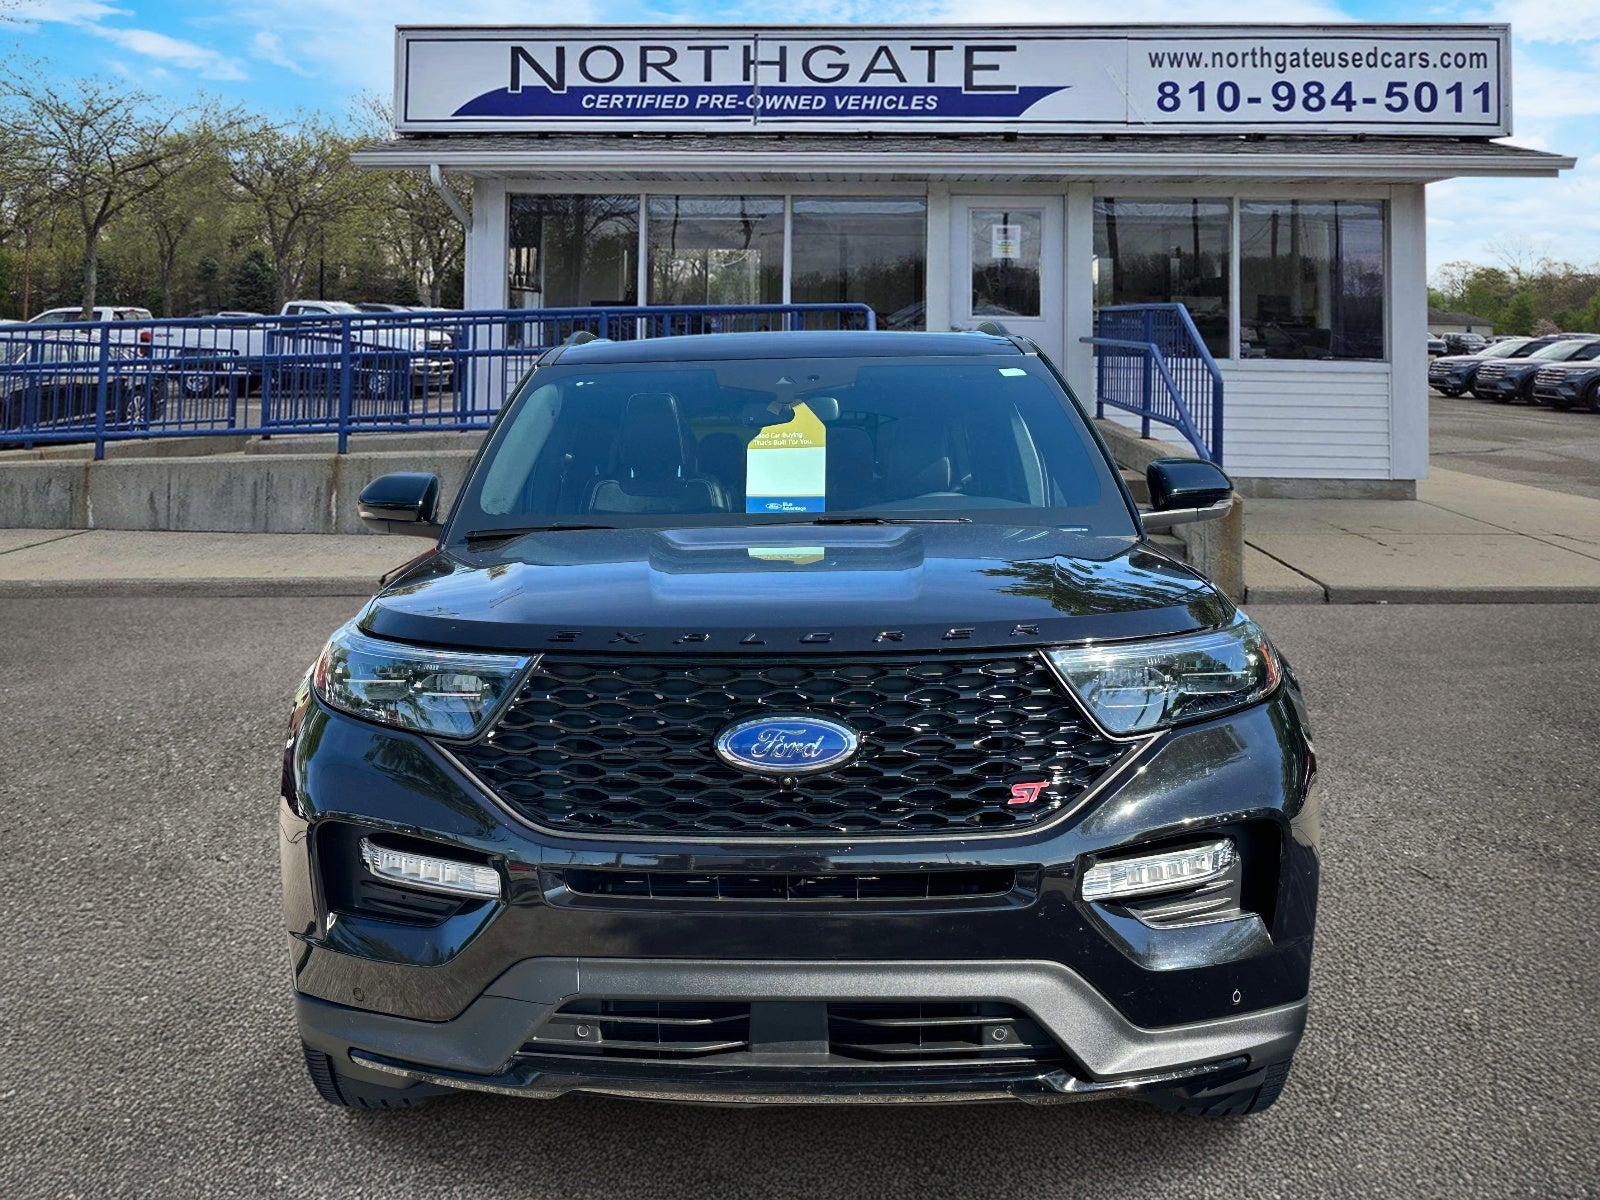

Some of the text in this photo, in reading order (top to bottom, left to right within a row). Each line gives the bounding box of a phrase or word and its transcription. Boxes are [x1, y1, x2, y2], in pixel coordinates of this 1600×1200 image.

[510, 45, 1017, 92] NORTHGATE
[1148, 46, 1488, 74] www.northgateusedcars.com
[581, 94, 939, 110] CERTIFIED PRE-OWNED VEHICLES
[1156, 80, 1491, 114] 810-984-5011
[547, 623, 1040, 645] EXPLORER
[751, 728, 825, 758] Ford
[1007, 780, 1051, 805] ST
